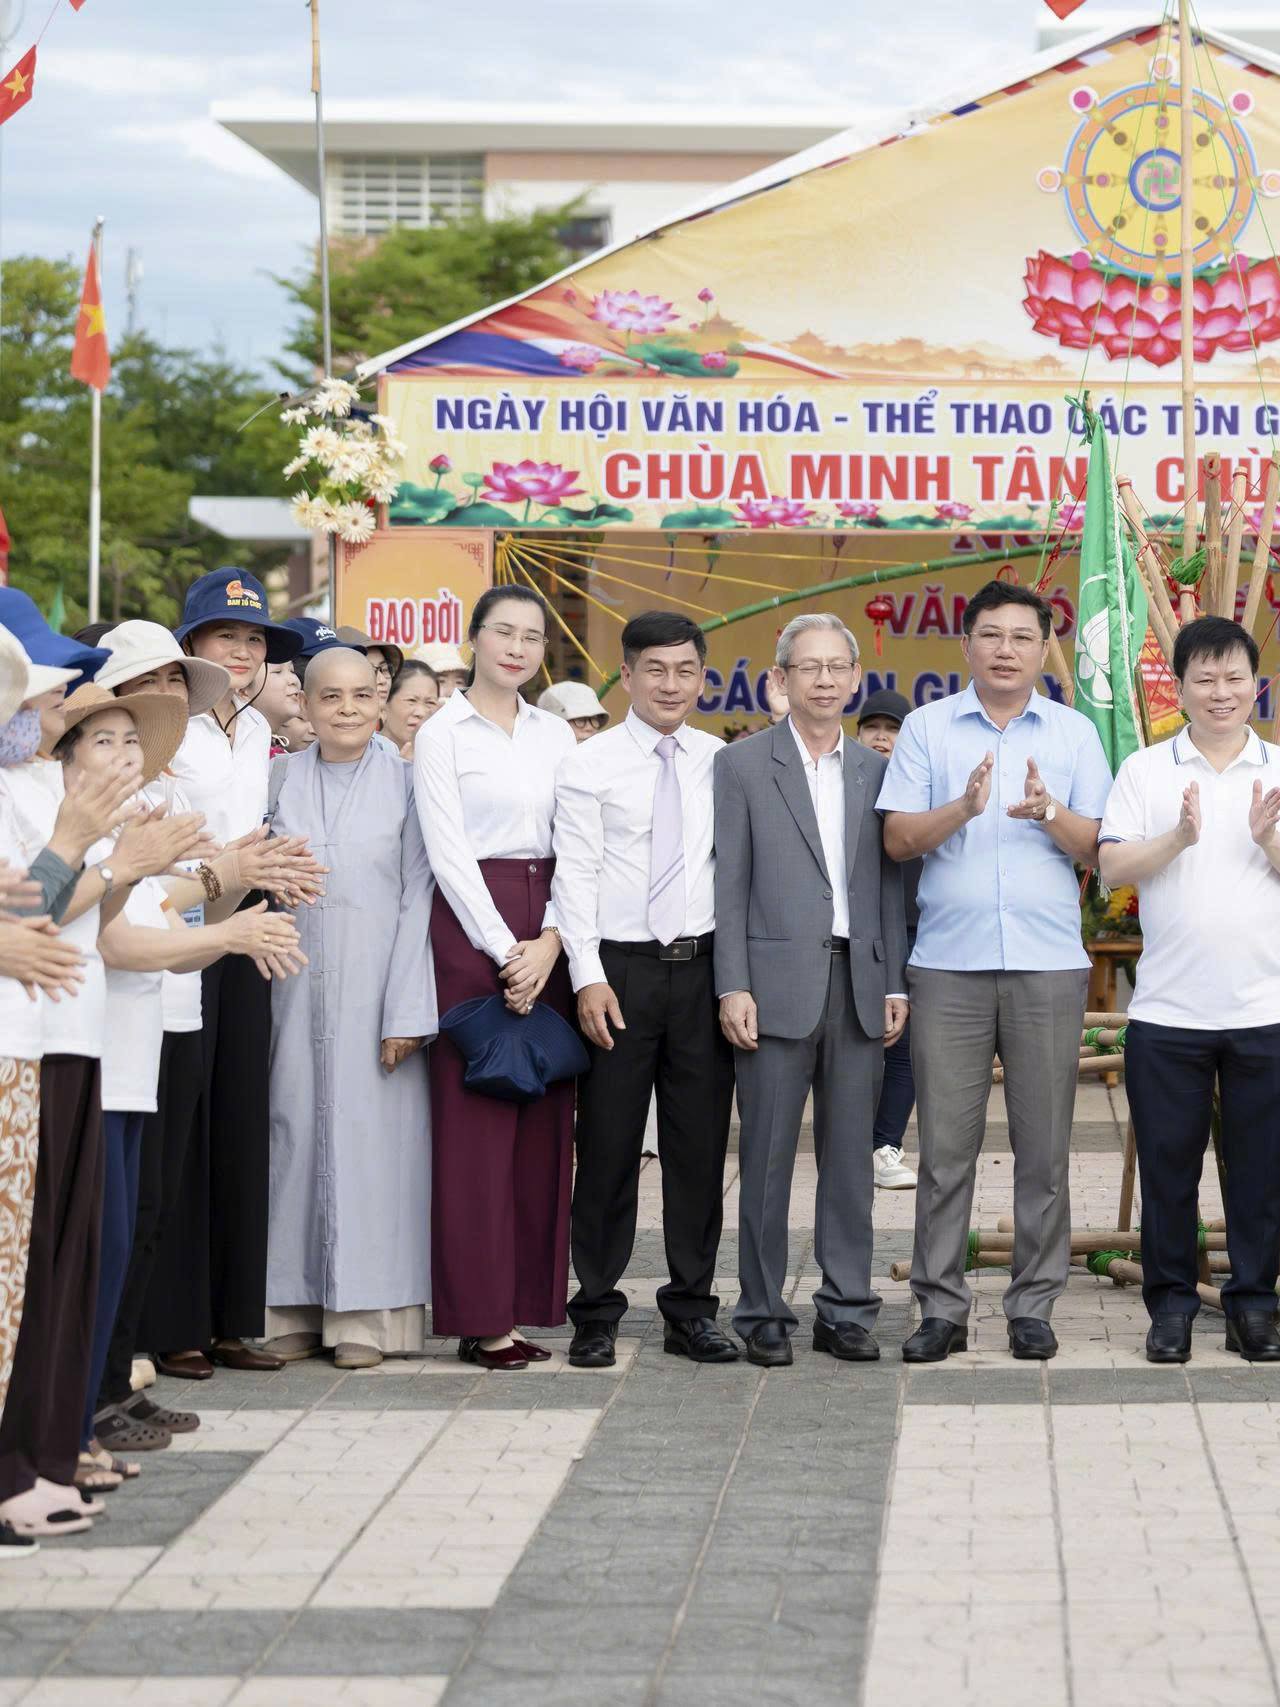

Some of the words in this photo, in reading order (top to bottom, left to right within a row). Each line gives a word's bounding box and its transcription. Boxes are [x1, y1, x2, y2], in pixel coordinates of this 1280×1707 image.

[436, 392, 545, 431] NGÀY
[561, 393, 627, 438] HỘI
[642, 393, 723, 432] VĂN
[739, 394, 820, 432] HÓA
[863, 389, 938, 434] THỂ
[950, 402, 1052, 434] THAO
[1068, 397, 1147, 436] CÁC
[1162, 397, 1240, 436] TÔN
[605, 443, 769, 501] CHÙA
[791, 454, 950, 501] MINH
[972, 445, 1088, 502] TÂN
[423, 591, 459, 644] ĐỜI
